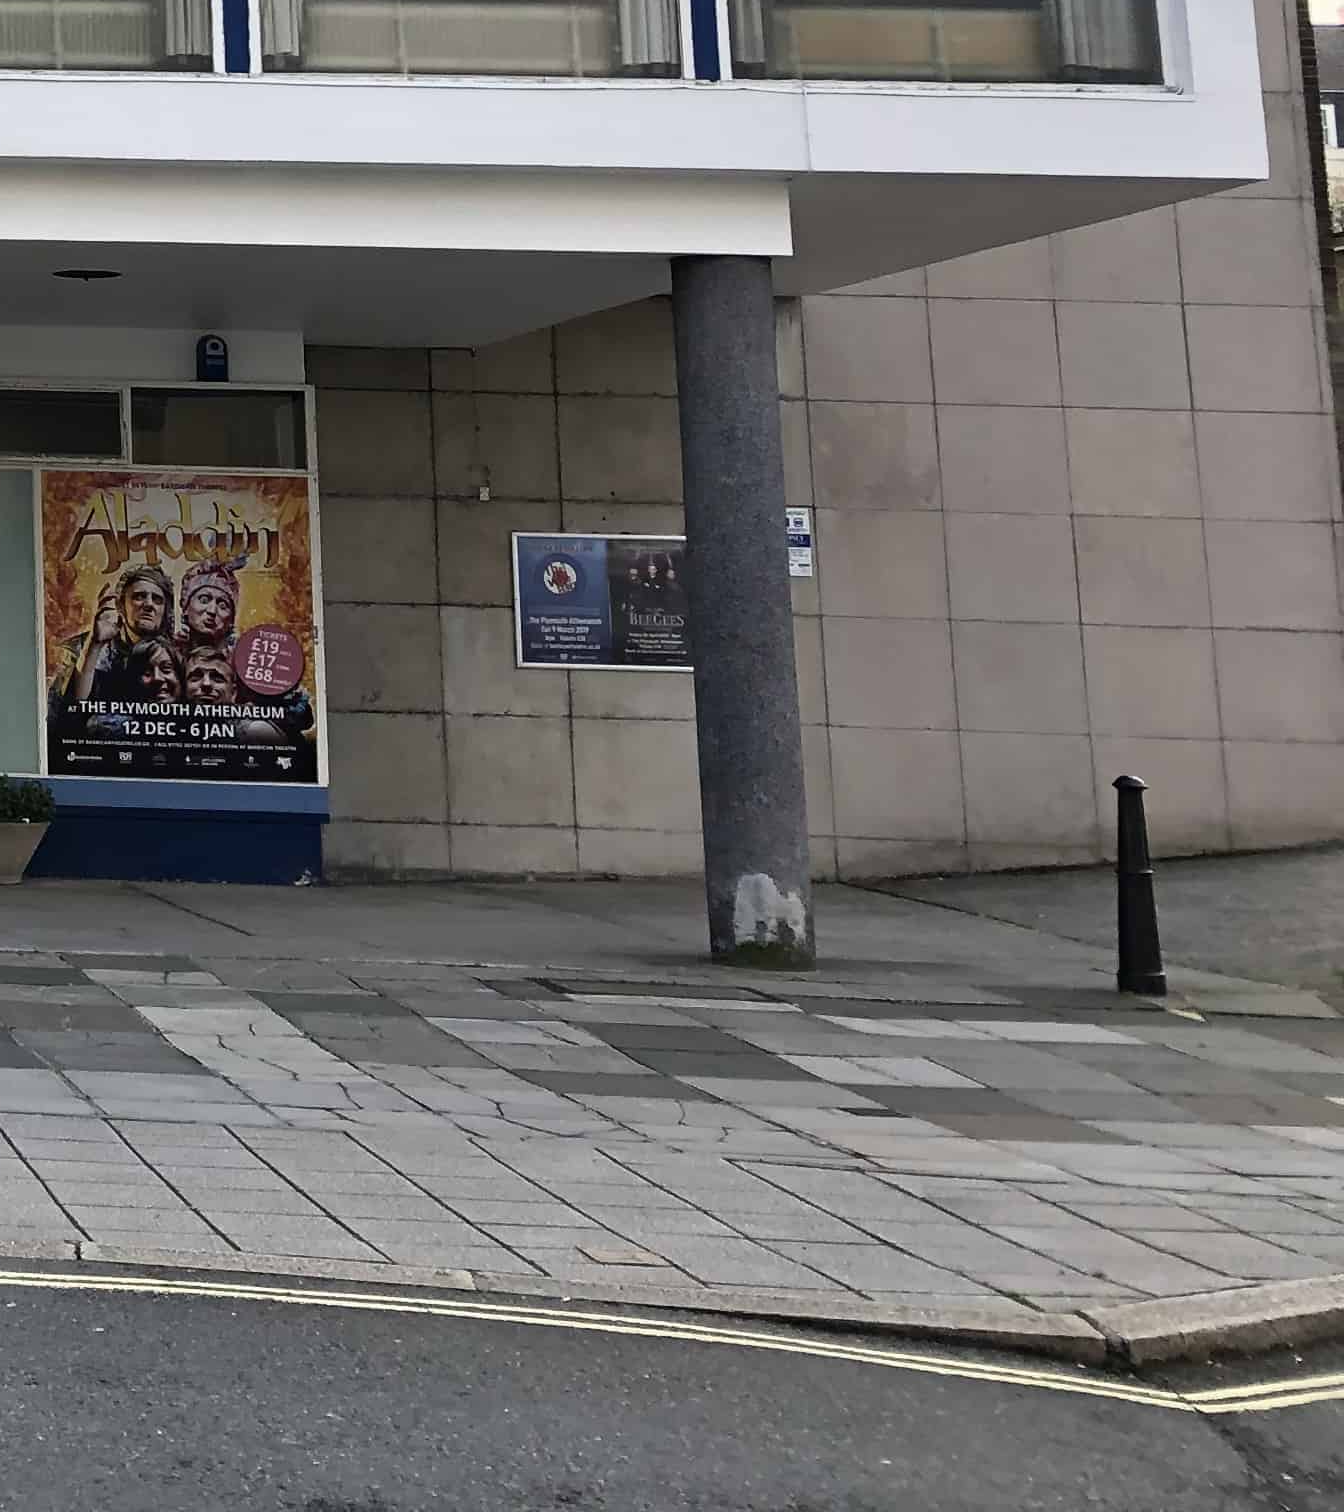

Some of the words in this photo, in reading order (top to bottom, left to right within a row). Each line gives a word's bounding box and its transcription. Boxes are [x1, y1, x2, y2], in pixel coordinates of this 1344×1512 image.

[64, 490, 280, 575] Aladdin
[251, 638, 280, 655] £19
[247, 652, 277, 668] £17
[244, 666, 273, 683] £68
[79, 700, 107, 714] THE
[110, 702, 190, 717] PLYMOUTH
[193, 704, 285, 719] ATHENAEUM
[123, 721, 141, 735] 12
[145, 721, 176, 736] DEC
[189, 723, 200, 737] 6
[202, 723, 236, 740] JAN
